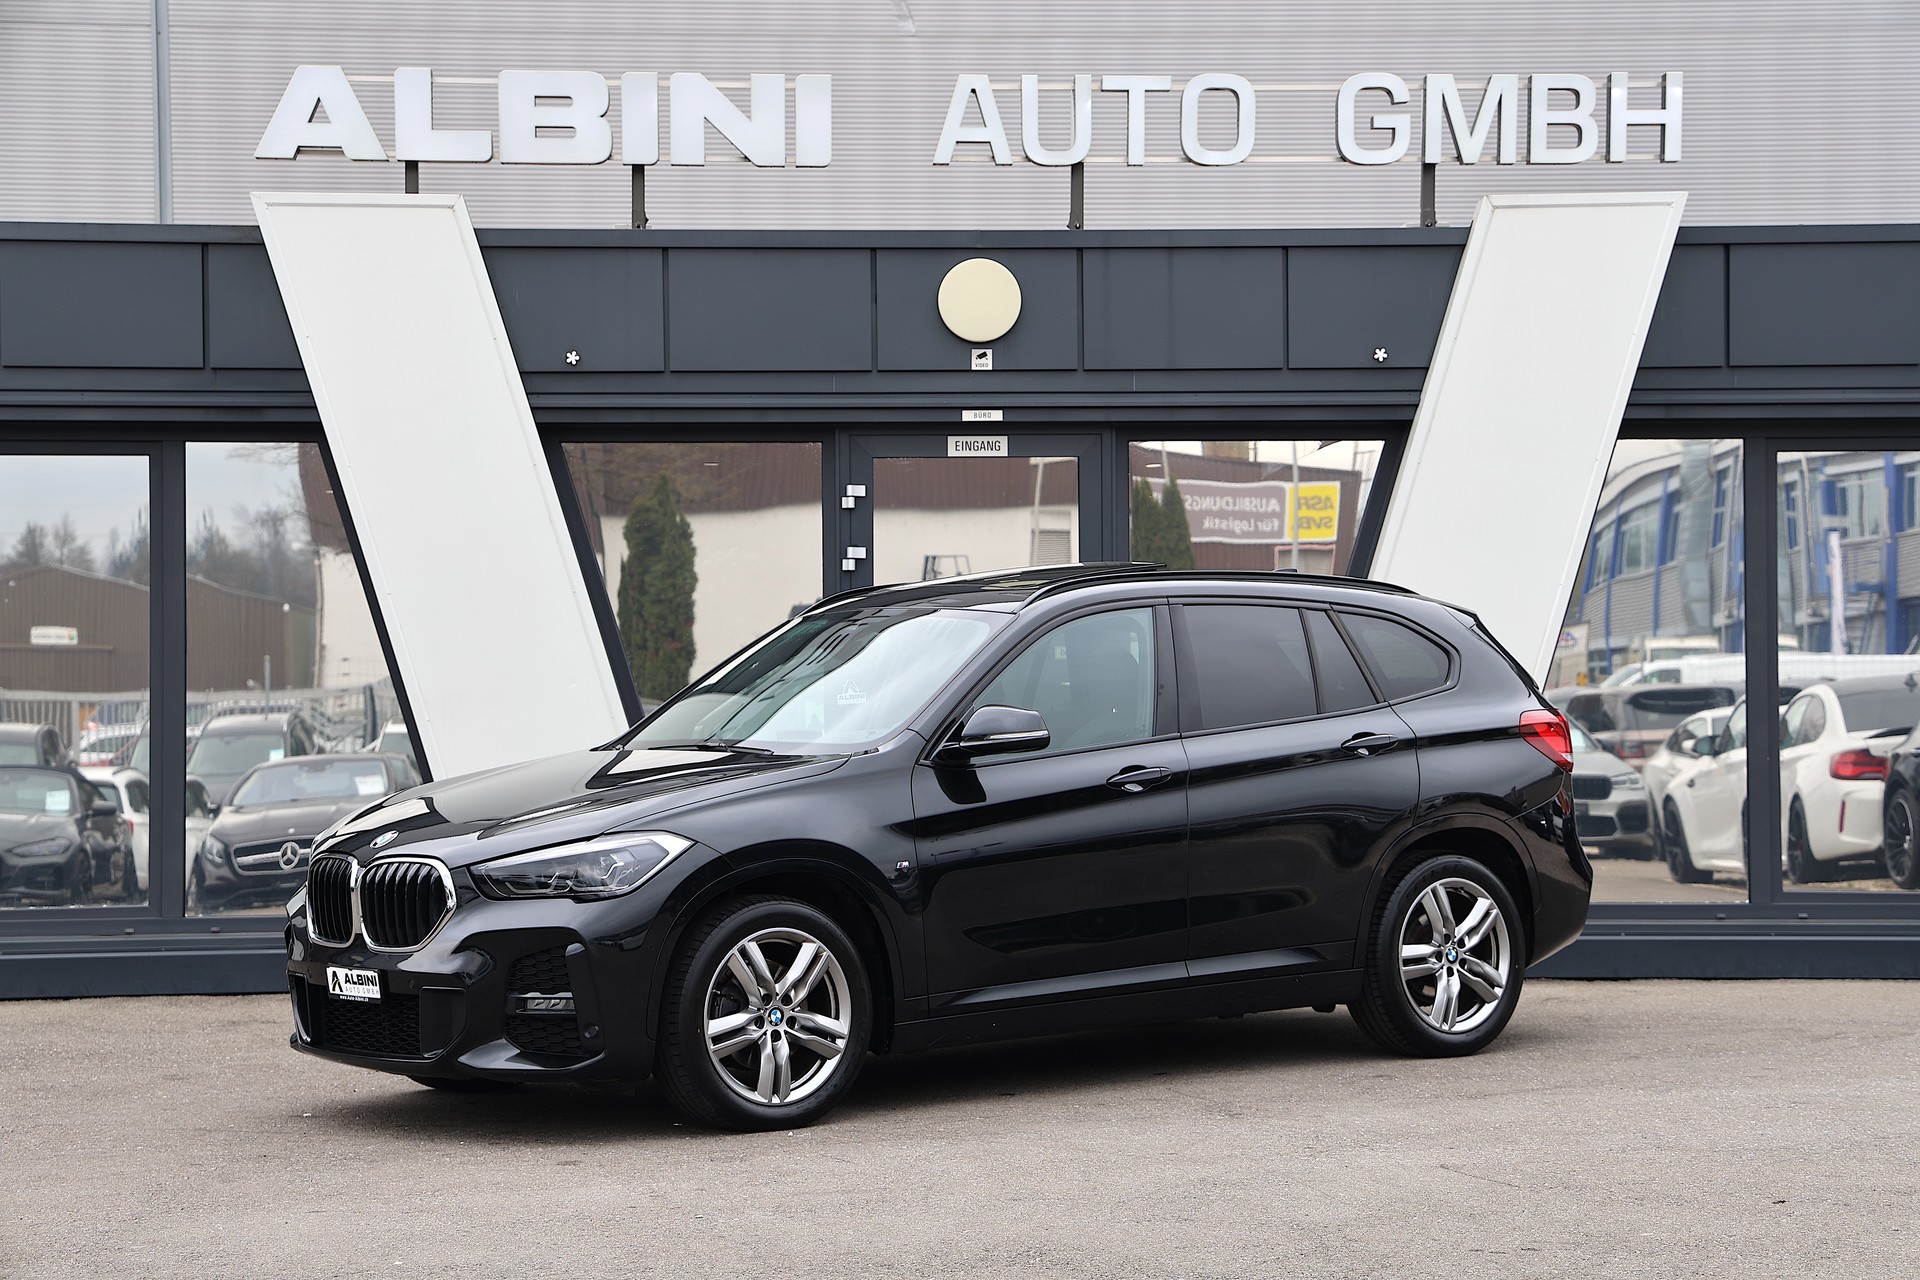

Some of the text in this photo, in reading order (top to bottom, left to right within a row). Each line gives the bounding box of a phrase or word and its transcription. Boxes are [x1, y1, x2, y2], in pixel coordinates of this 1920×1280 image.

[253, 65, 1684, 168] ALBINI AUTO GMBH
[973, 411, 992, 419] BÜRO
[954, 440, 1001, 452] EINGANG
[345, 973, 378, 987] ALBINI
[345, 986, 361, 994] AUTO
